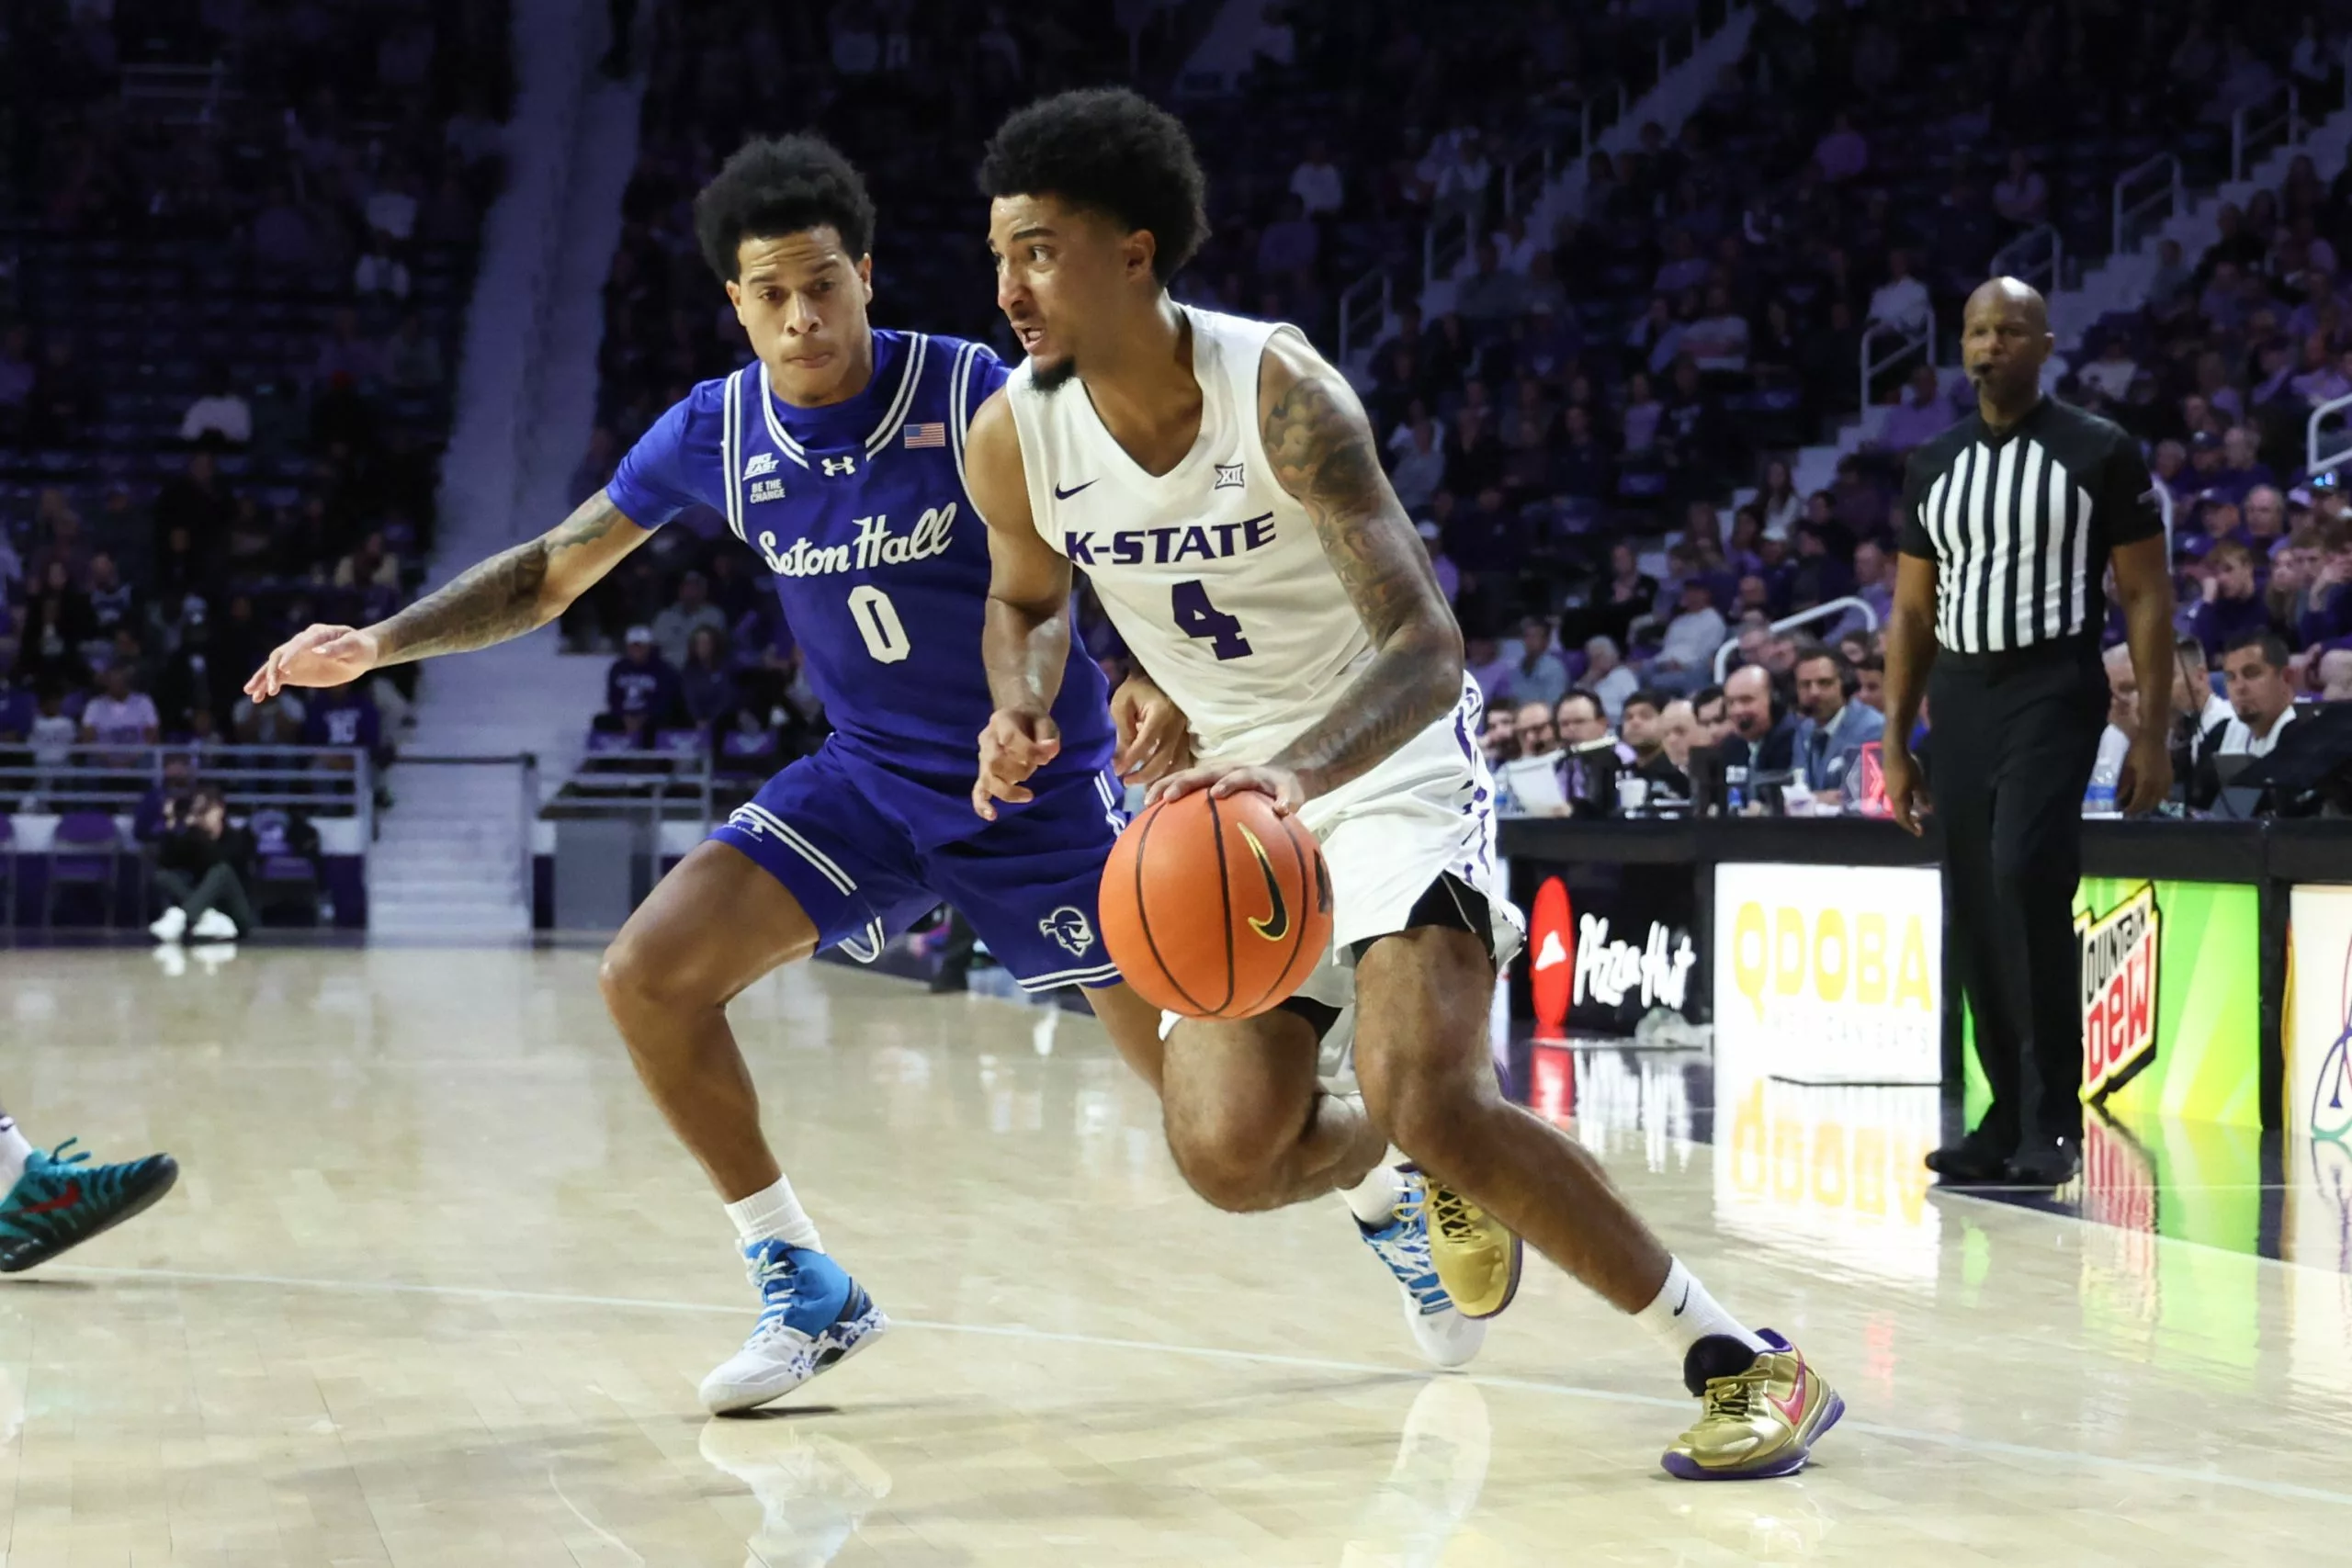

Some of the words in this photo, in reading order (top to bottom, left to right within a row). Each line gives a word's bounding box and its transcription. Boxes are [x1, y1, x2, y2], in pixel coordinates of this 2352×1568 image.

[743, 459, 780, 476] EAST
[750, 488, 786, 504] CHANGE
[751, 481, 764, 494] BE
[764, 479, 783, 491] THE
[1214, 462, 1245, 490] XII
[759, 531, 852, 578] Seton
[852, 502, 957, 570] Hall
[1064, 511, 1277, 566] K-STATE
[847, 585, 911, 664] 0
[1171, 579, 1254, 661] 4
[1573, 912, 1642, 1008] Pizza
[1640, 919, 1697, 1011] Hut
[1733, 900, 1933, 1025] QDOBA
[2084, 905, 2147, 1006] OUNTAIN
